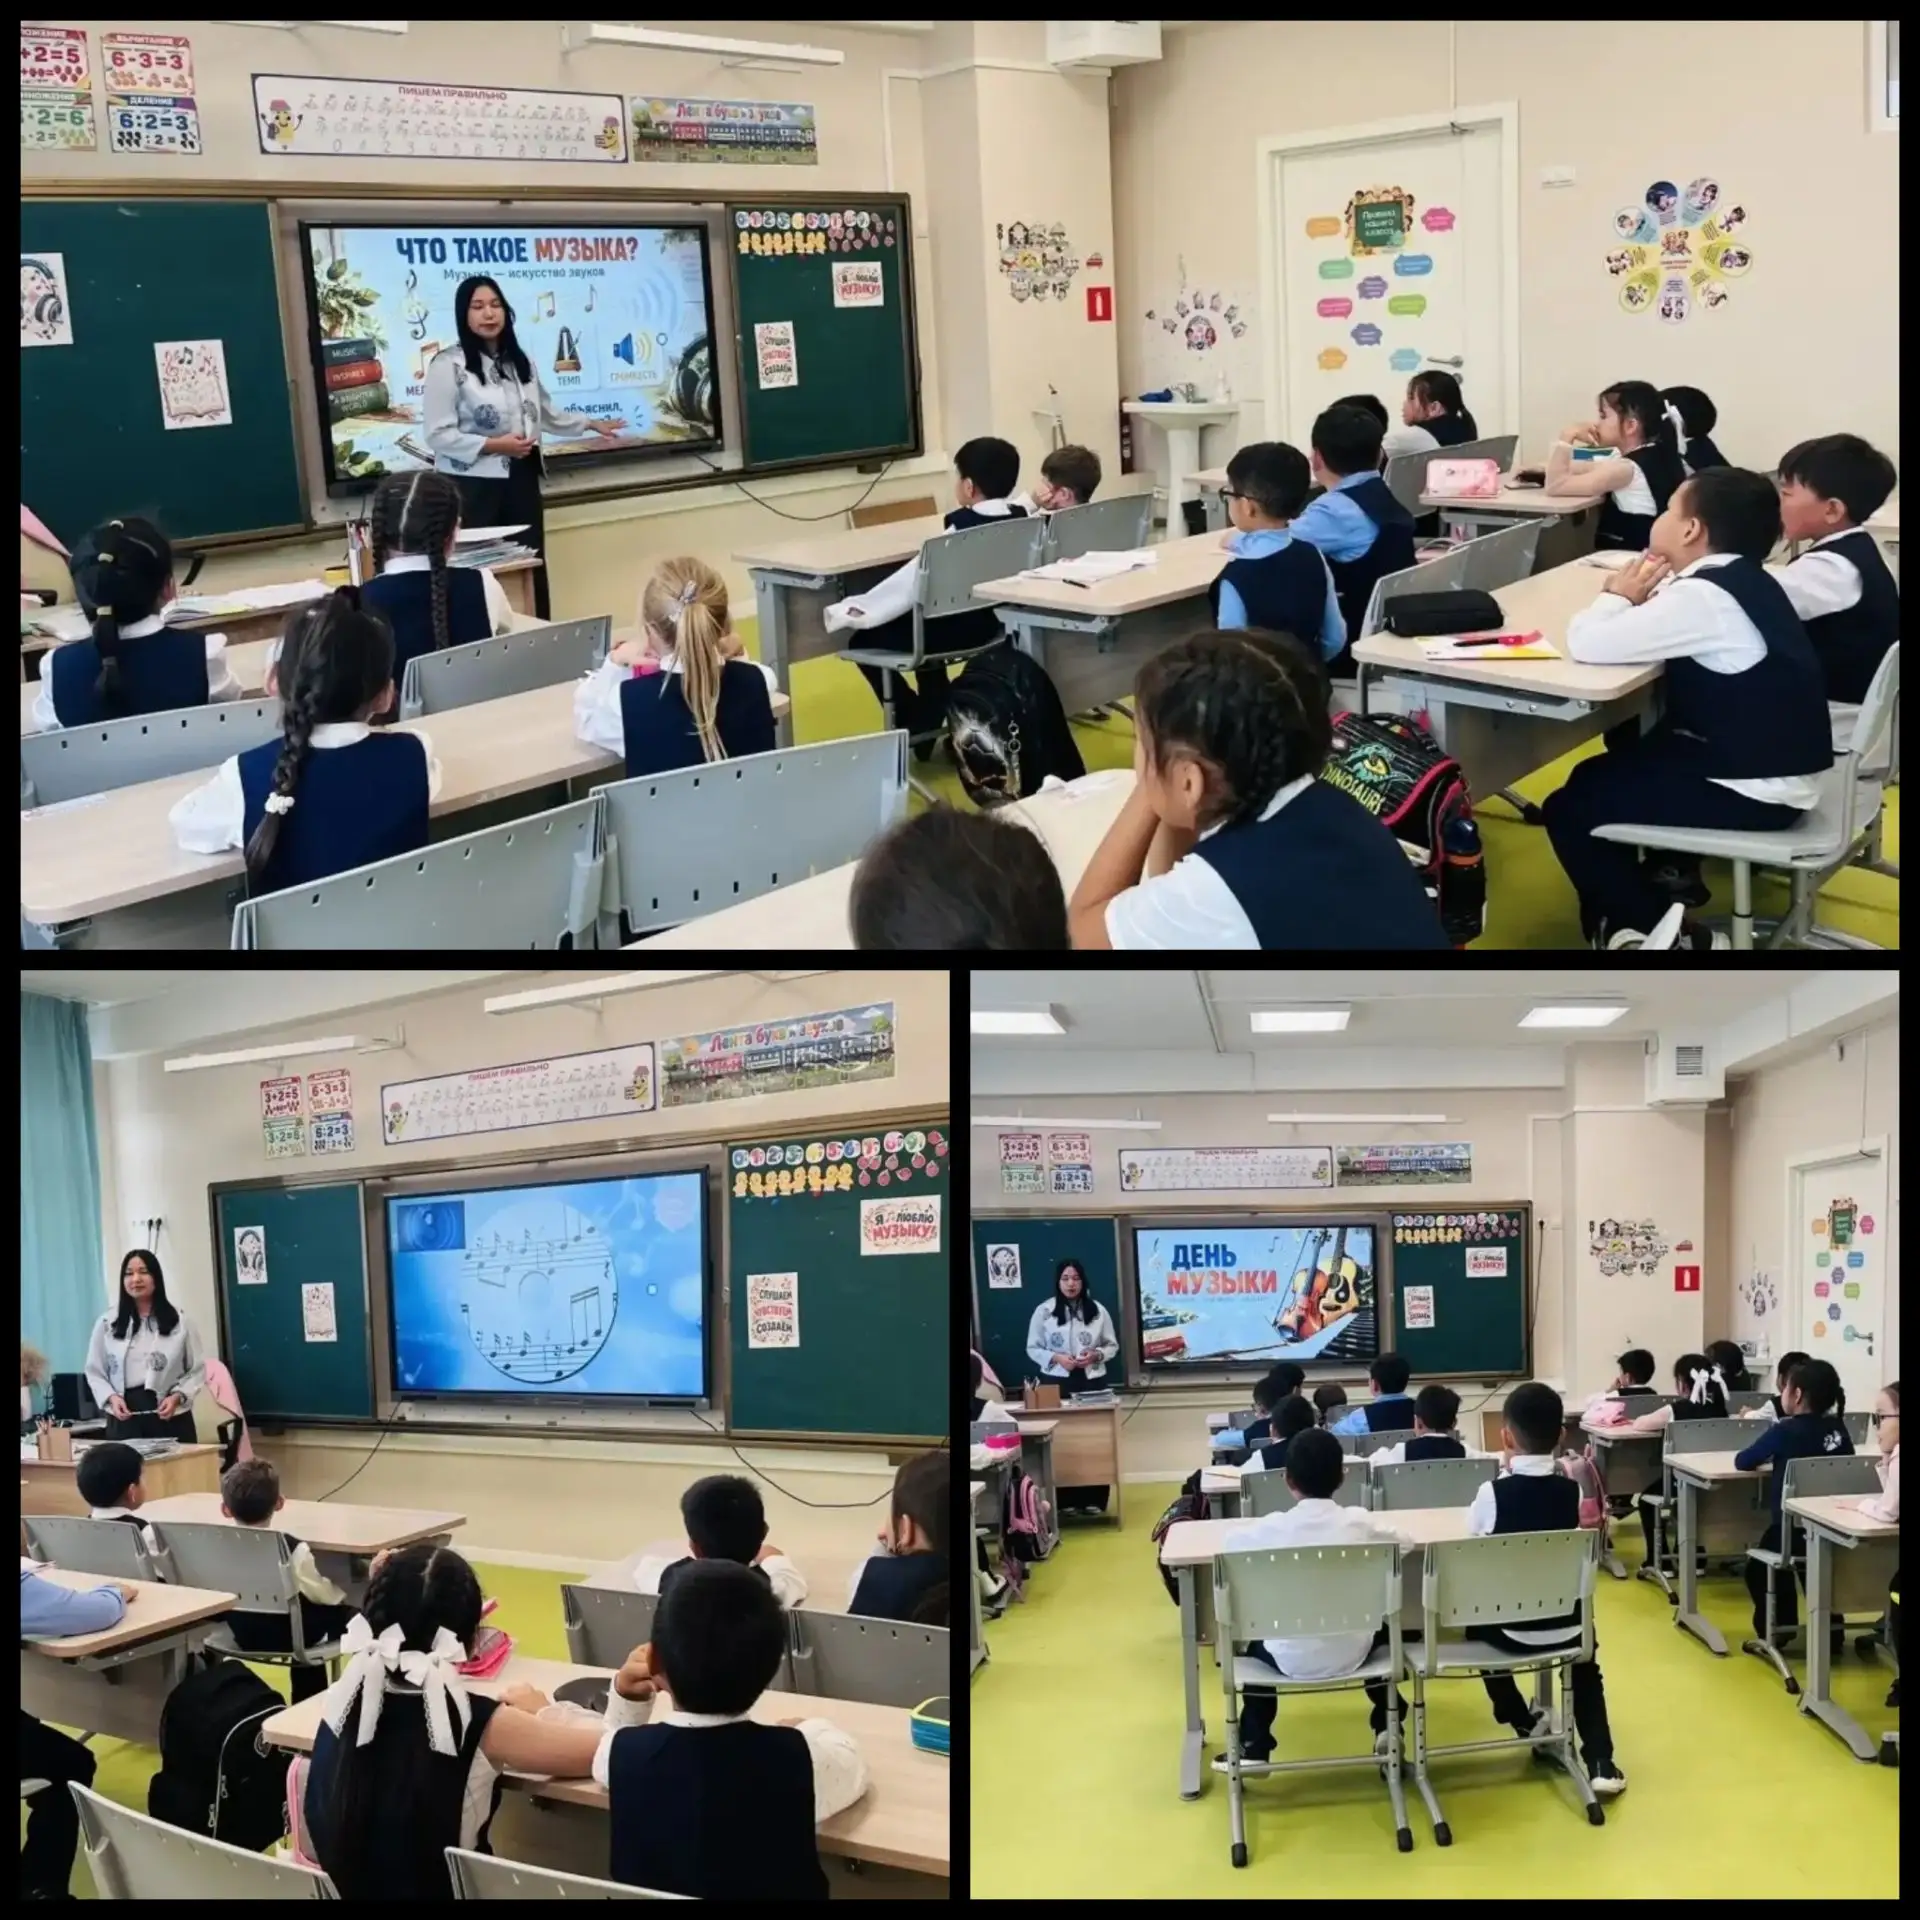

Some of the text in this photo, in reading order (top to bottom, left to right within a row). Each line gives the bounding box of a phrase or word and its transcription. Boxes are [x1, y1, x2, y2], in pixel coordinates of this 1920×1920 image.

[398, 86, 508, 101] ПИШЕМ ПРАВИЛЬНО
[396, 236, 640, 264] ЧТО ТАКОЕ МУЗЫКА?
[508, 267, 567, 279] искусство
[568, 267, 606, 278] звуков
[331, 347, 359, 358] MUSIC
[557, 376, 582, 387] ТЕМП
[1318, 762, 1386, 815] DINOSAURS
[709, 1033, 753, 1053] Лента
[875, 1213, 934, 1225] Я ЛЮБЛЮ
[873, 1224, 937, 1241] МУЗЫКУ!
[1171, 1243, 1237, 1271] ДЕНЬ
[1166, 1270, 1278, 1296] МУЗЫКИ
[759, 1289, 792, 1300] СЛУШАЕМ
